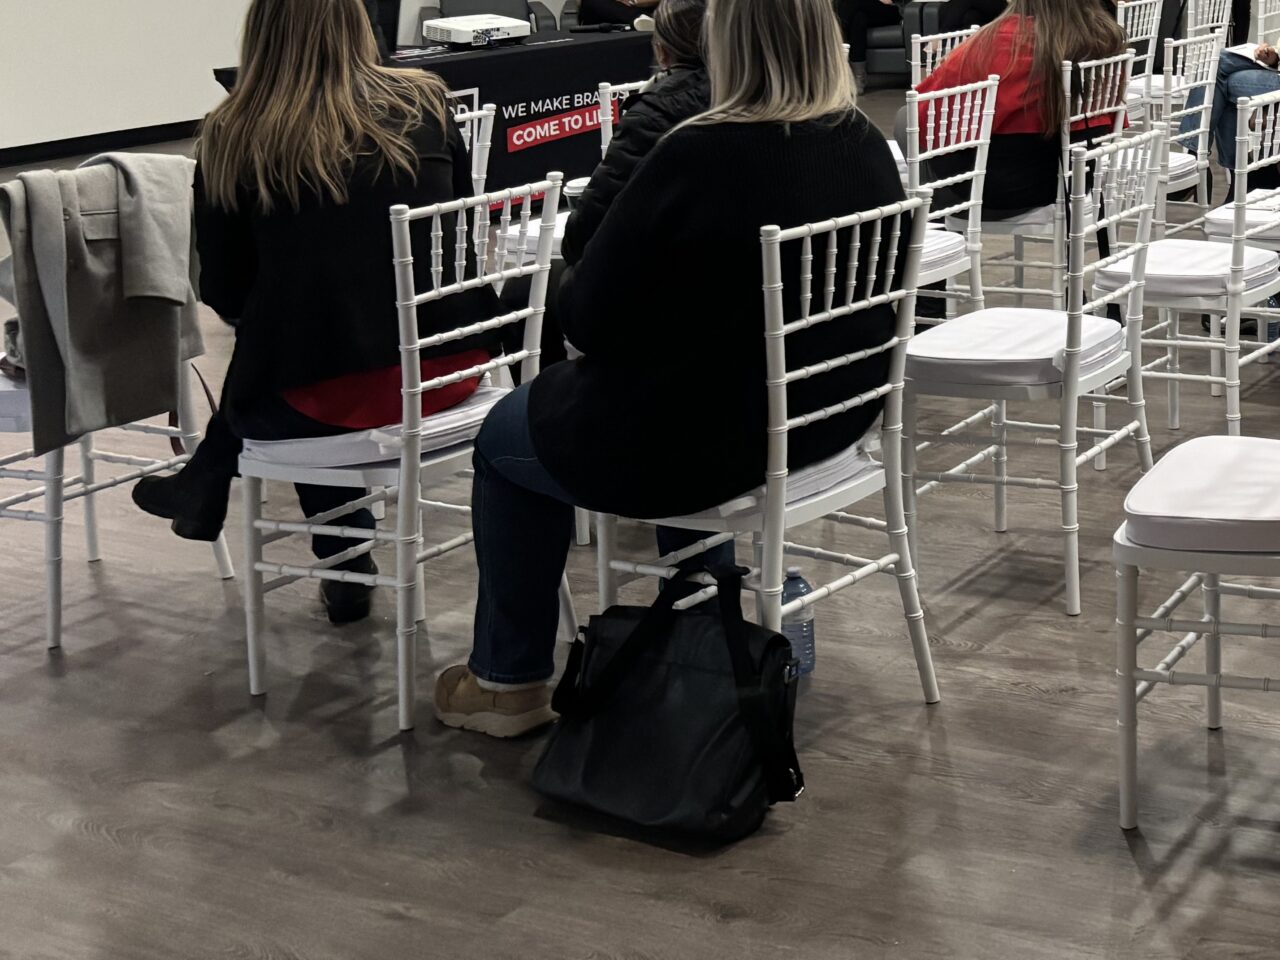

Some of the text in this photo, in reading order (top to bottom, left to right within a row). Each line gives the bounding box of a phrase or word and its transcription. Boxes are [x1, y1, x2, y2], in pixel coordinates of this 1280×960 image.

[502, 90, 626, 119] WE MAKE BRADS
[512, 120, 560, 145] COME
[562, 114, 582, 132] TO
